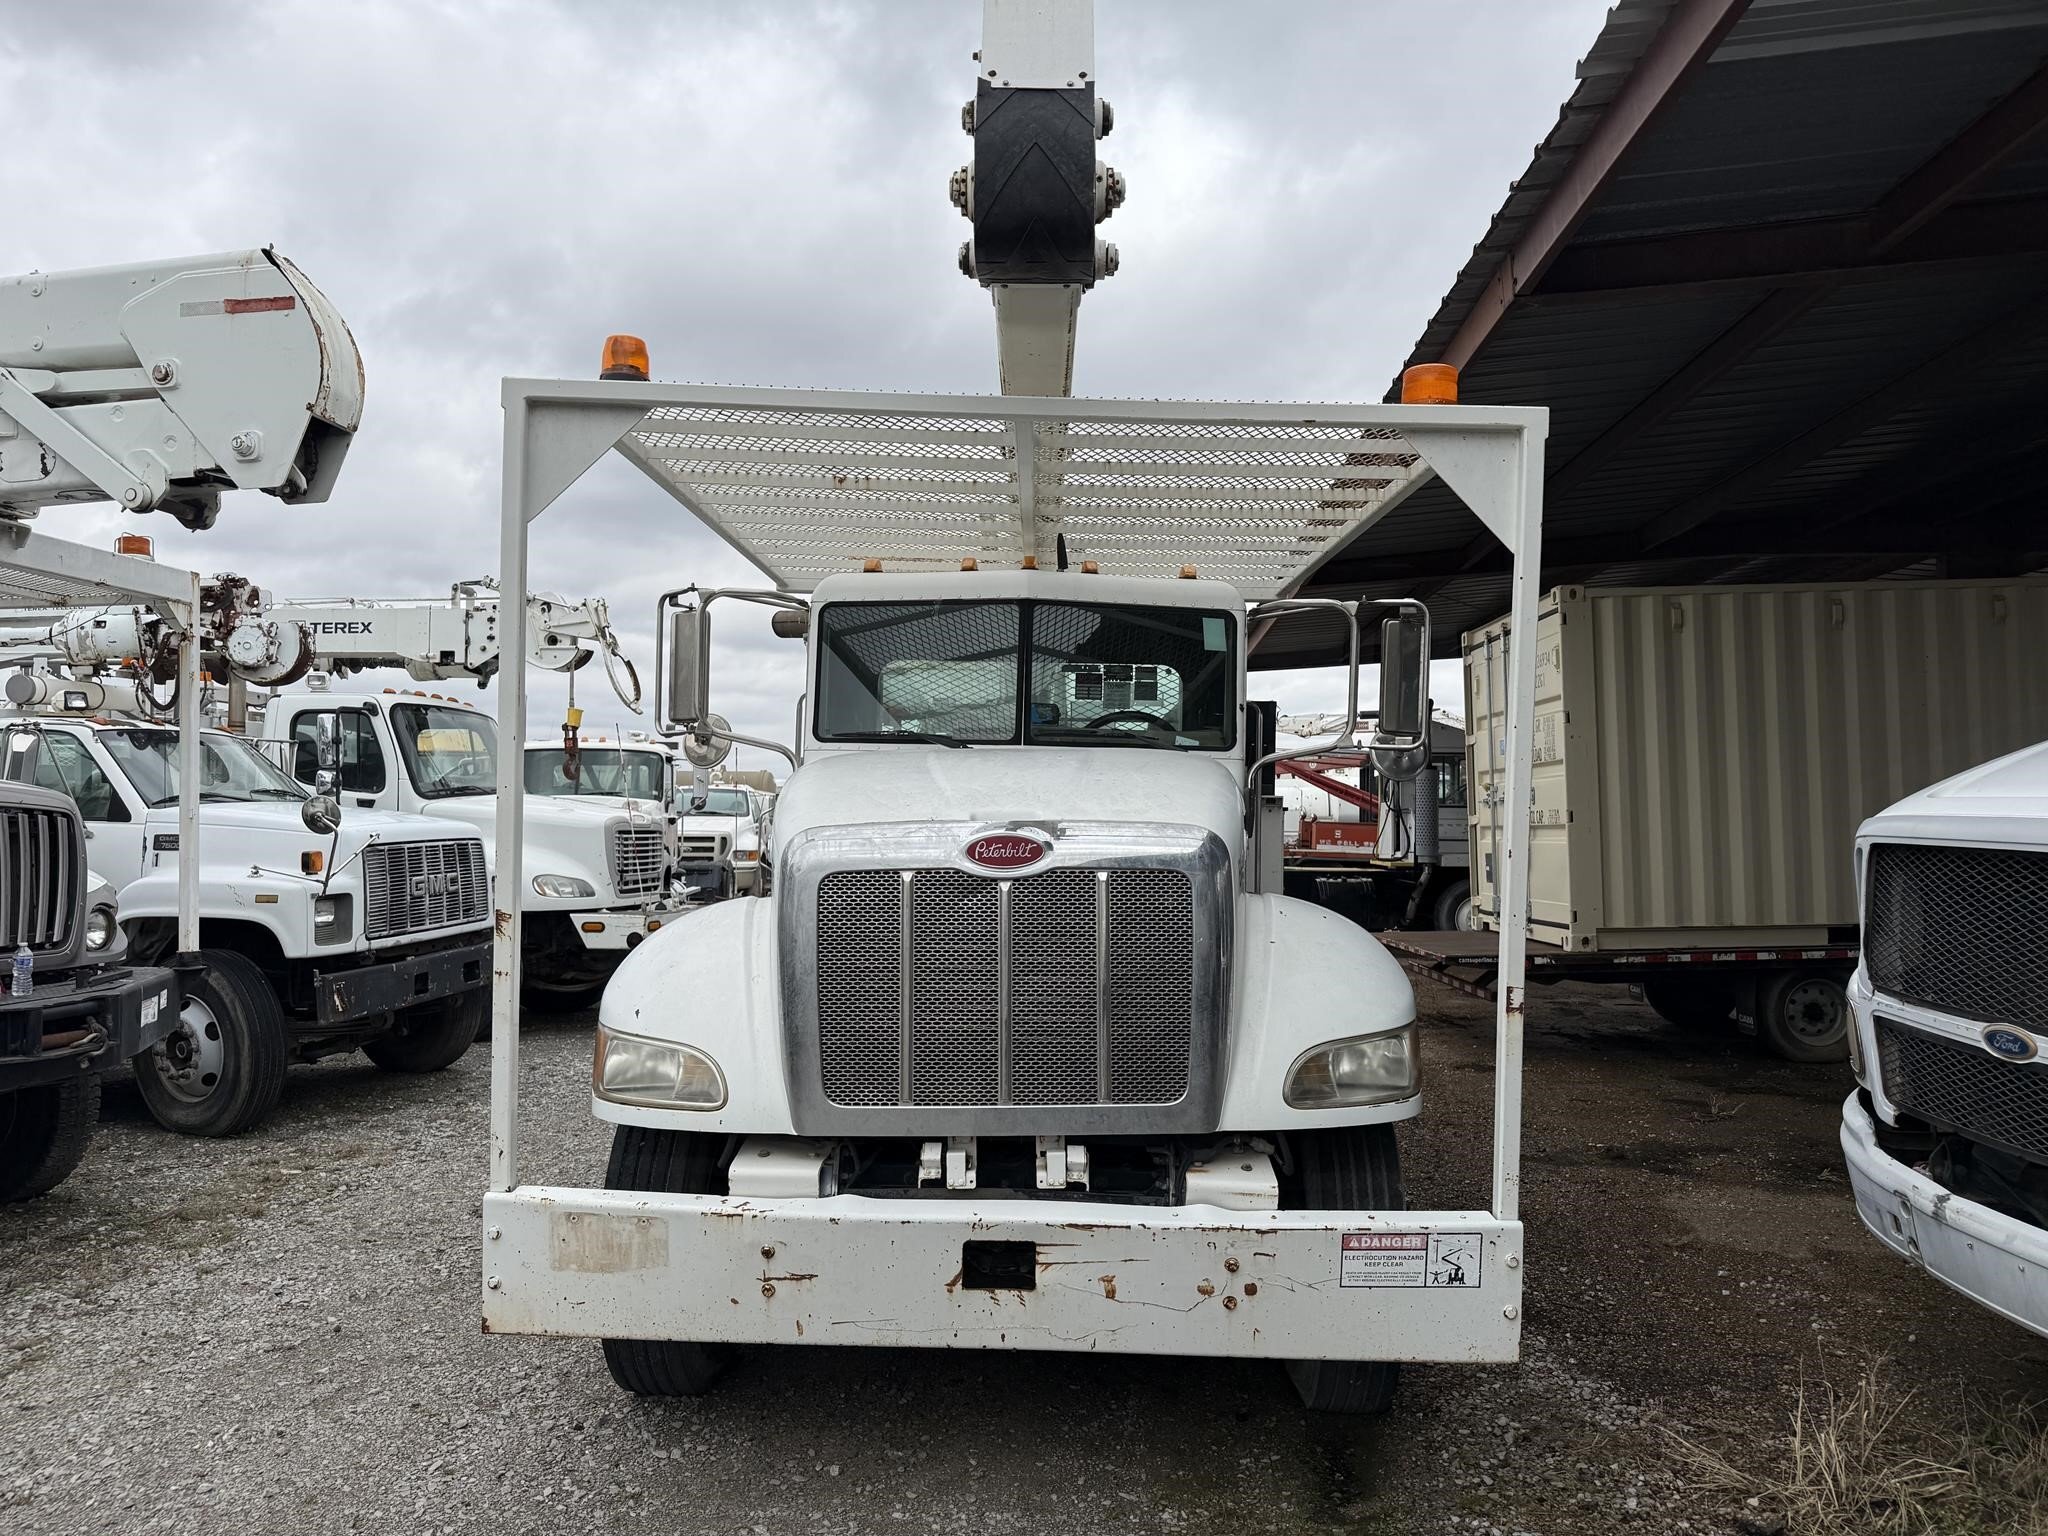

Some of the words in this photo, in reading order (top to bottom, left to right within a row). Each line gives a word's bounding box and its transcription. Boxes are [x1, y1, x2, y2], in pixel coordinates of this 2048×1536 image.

[309, 621, 373, 634] TEREX
[975, 841, 1037, 859] Peterbilt
[411, 873, 459, 897] GMC
[1994, 1034, 2020, 1052] Ford
[1361, 1237, 1422, 1248] DANGER
